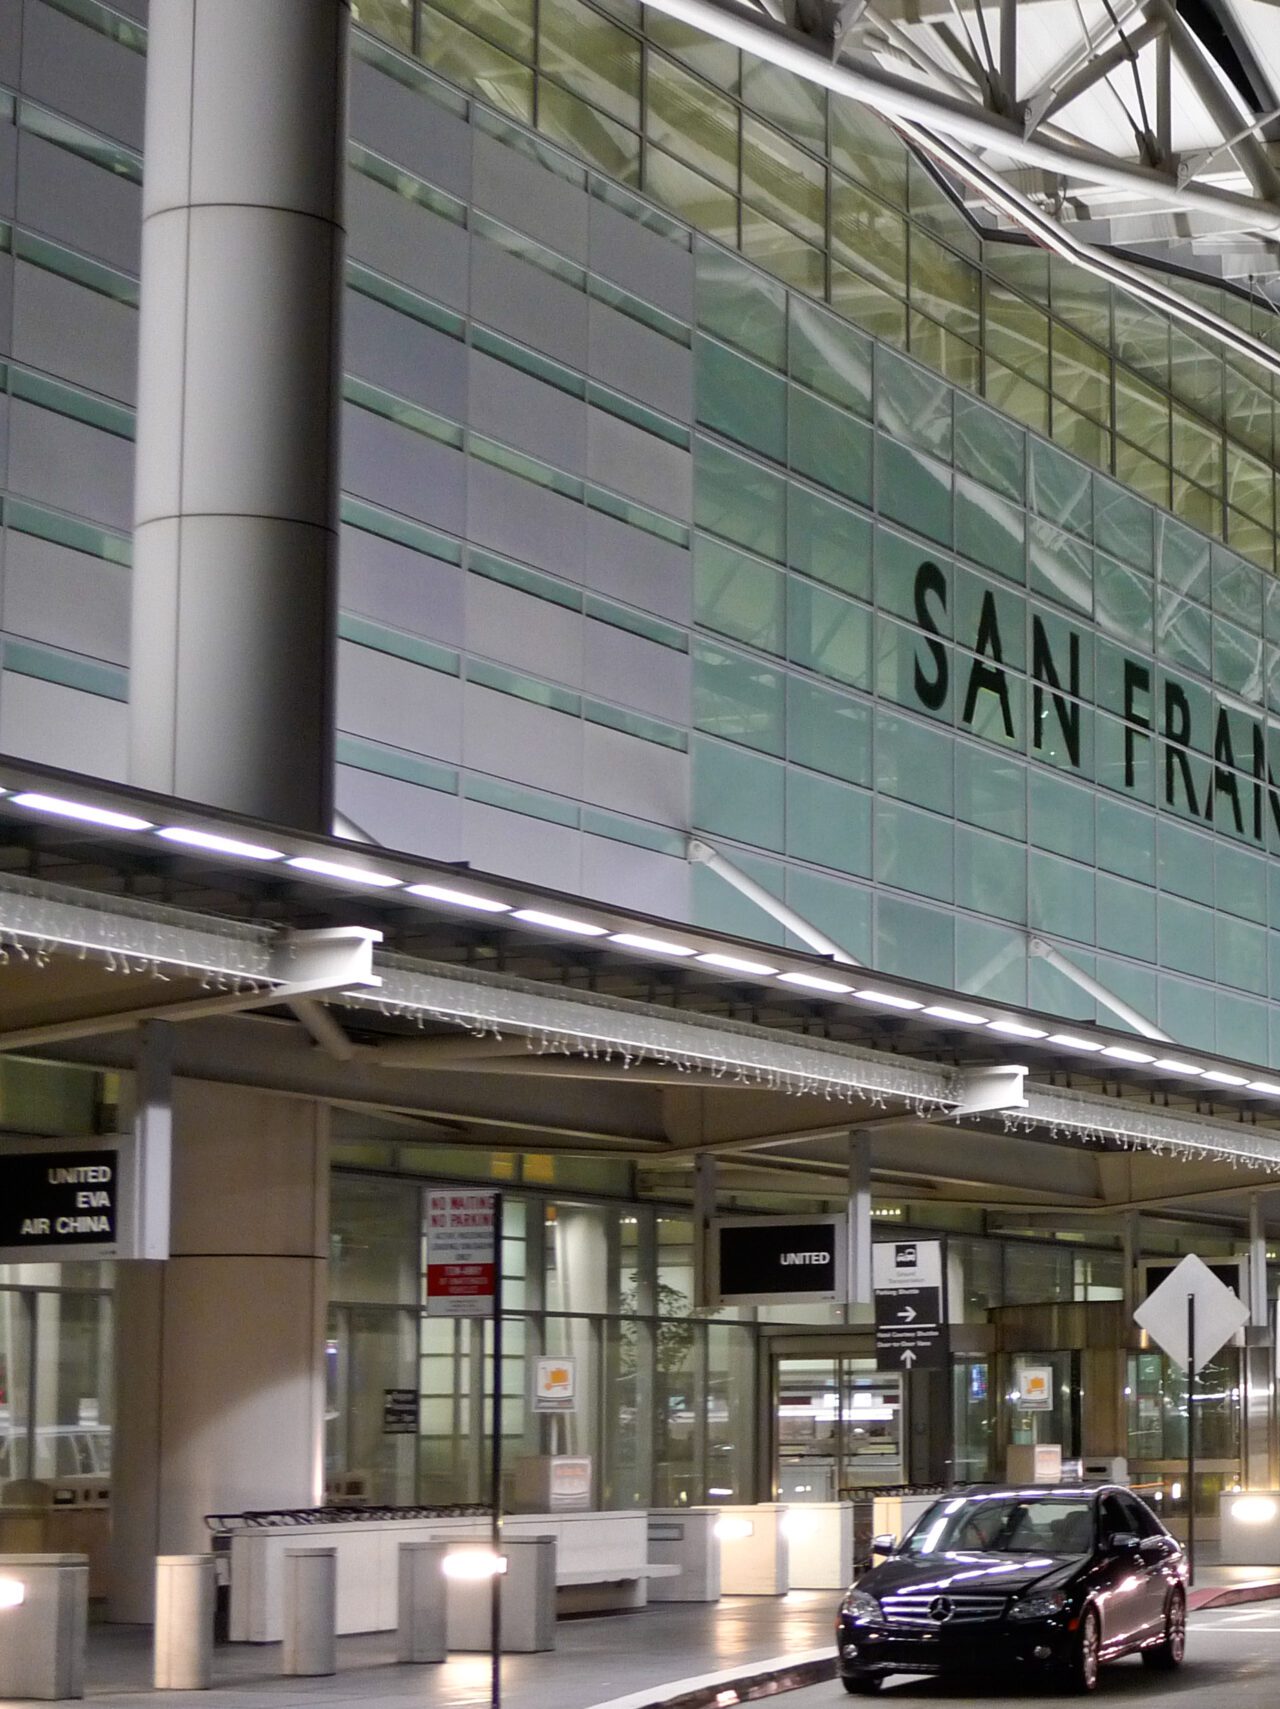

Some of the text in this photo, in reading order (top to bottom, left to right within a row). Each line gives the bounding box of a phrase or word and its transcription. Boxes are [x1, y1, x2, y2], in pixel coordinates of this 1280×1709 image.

[914, 561, 1080, 768] SAN
[47, 1166, 112, 1184] UNITED
[75, 1191, 112, 1208] EVA
[431, 1197, 446, 1210] NO
[20, 1216, 111, 1235] AIR CHINA
[431, 1213, 495, 1227] NO PARKIN
[779, 1252, 831, 1265] UNITED
